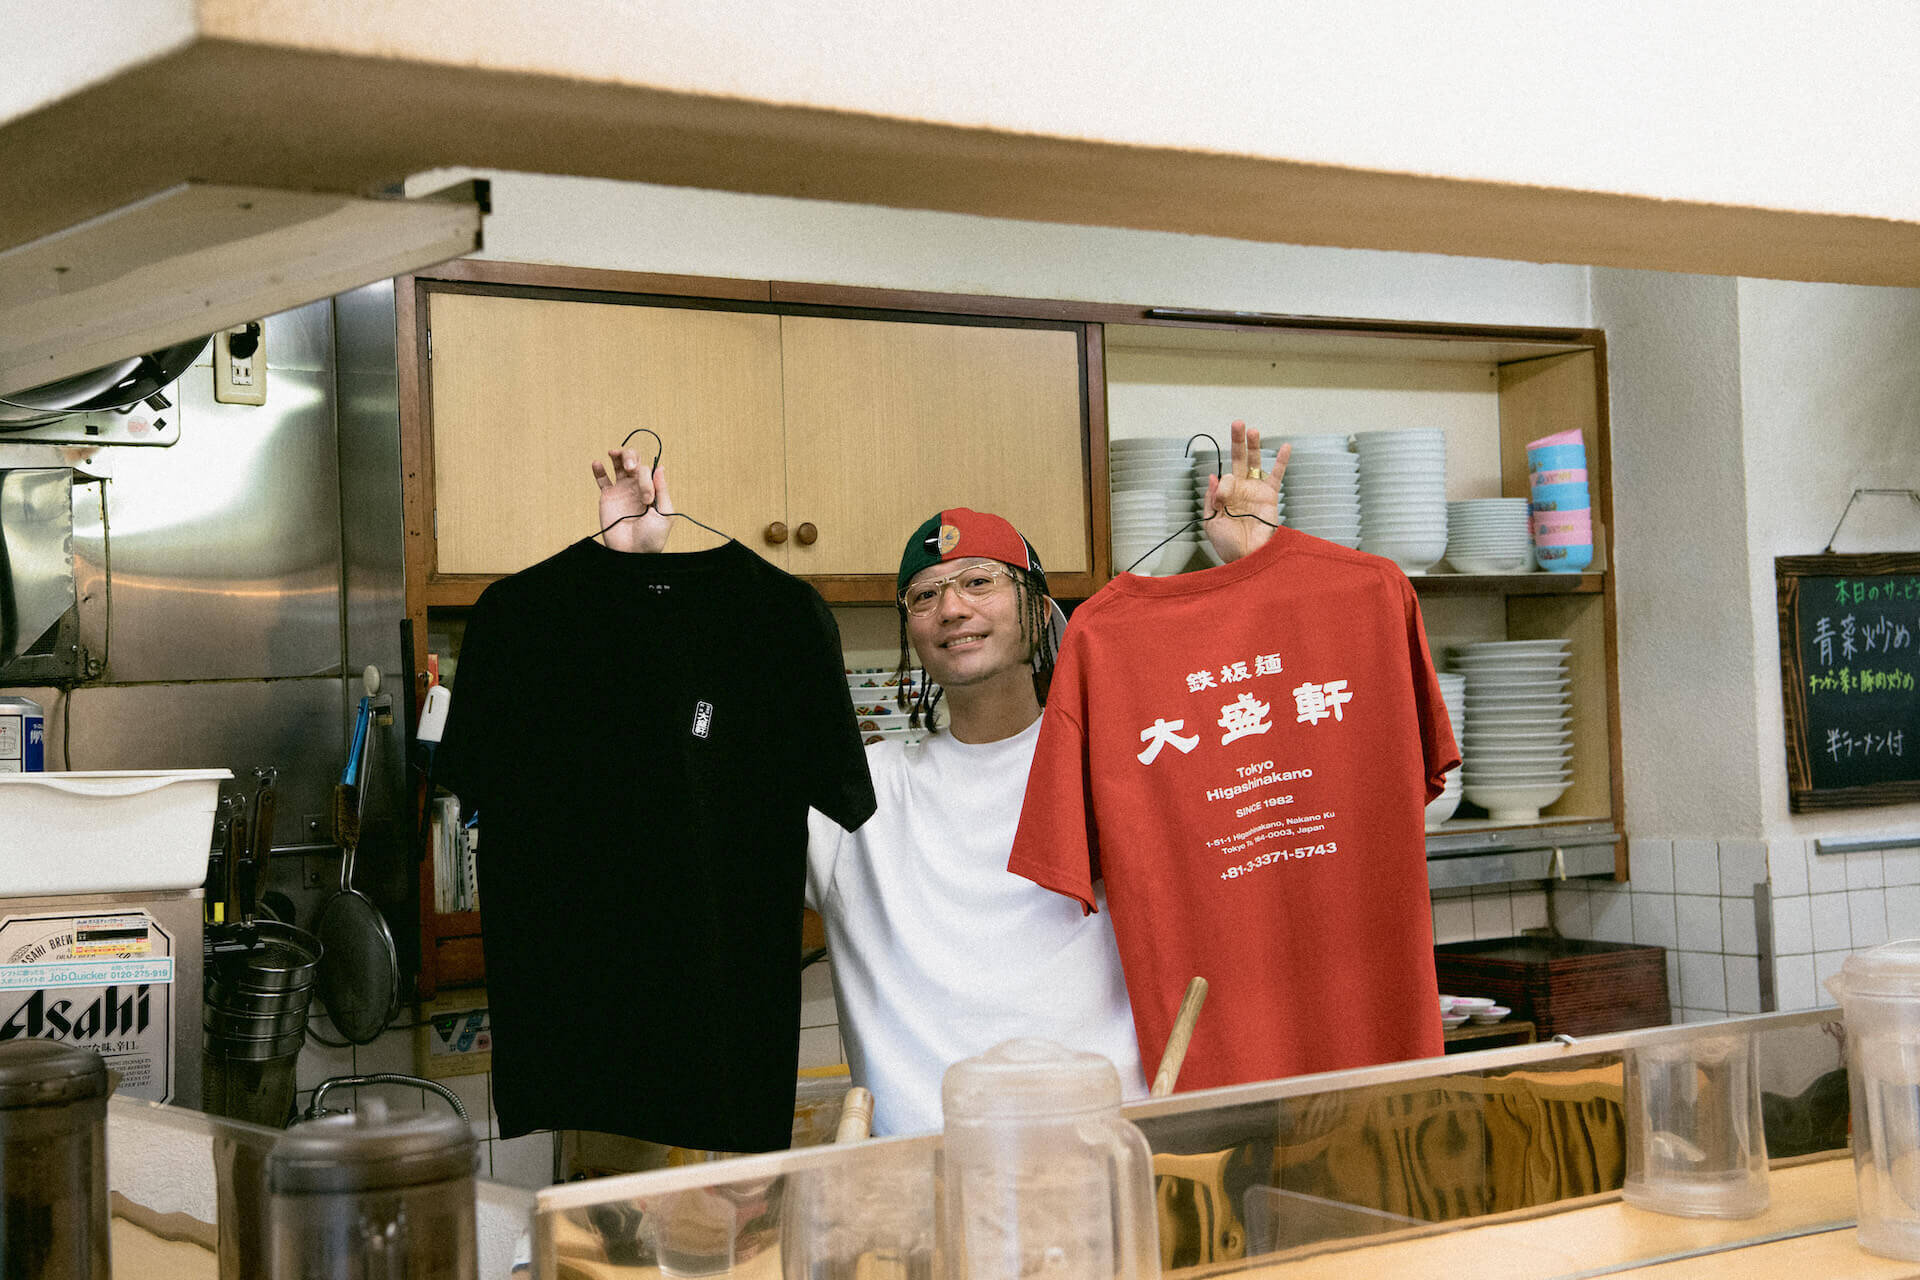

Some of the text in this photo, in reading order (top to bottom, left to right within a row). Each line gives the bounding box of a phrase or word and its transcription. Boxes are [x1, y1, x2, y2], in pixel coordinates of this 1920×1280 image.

[1186, 653, 1283, 693] 鉄板麺
[1137, 679, 1354, 765] 大盛軒
[1206, 768, 1313, 801] Higashinakano
[1236, 760, 1274, 778] Tokyo
[1236, 795, 1294, 818] SINCE 1982
[1286, 813, 1321, 826] Nakano
[1323, 811, 1335, 820] Ku
[1221, 842, 1246, 855] Tokyo
[1296, 824, 1325, 836] Japan
[0, 983, 150, 1041] Asahi
